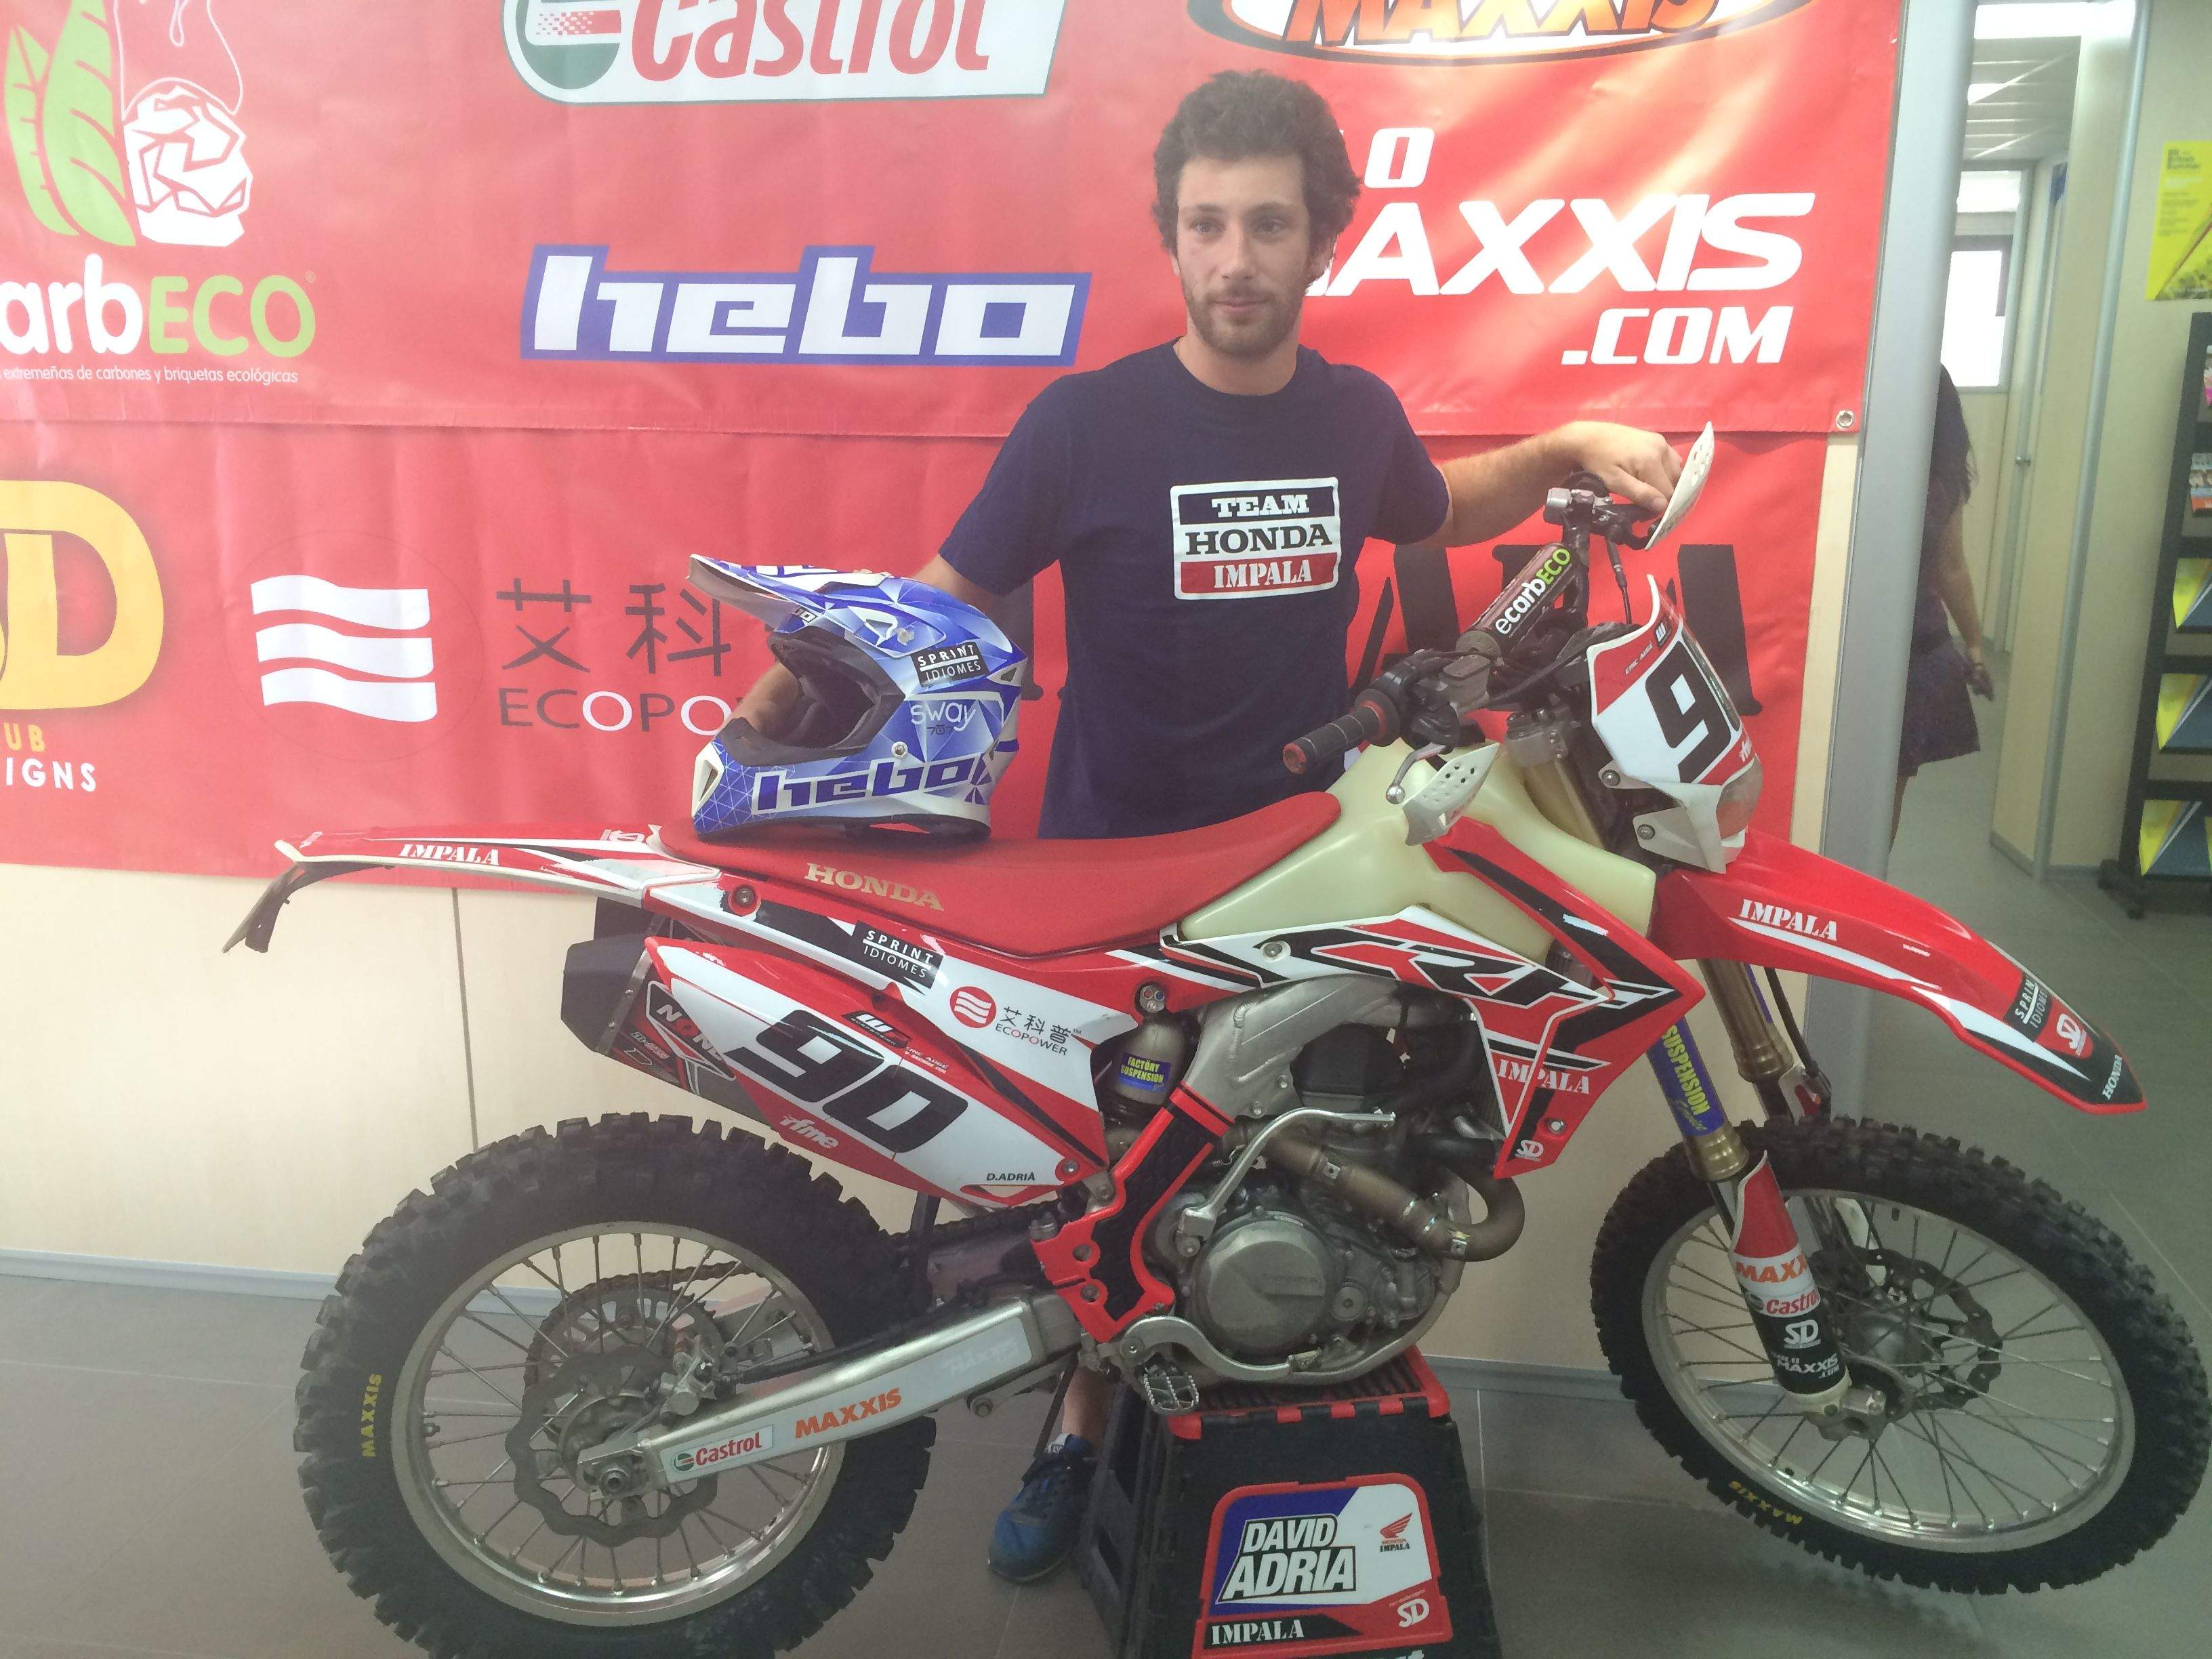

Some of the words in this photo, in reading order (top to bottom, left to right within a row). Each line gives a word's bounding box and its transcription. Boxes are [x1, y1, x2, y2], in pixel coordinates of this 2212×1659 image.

[1364, 127, 1435, 188] O
[1305, 192, 1816, 297] AXXIS
[534, 255, 1076, 356] hebo
[1561, 306, 1794, 365] .COM
[3, 365, 74, 381] extremeñas
[77, 365, 93, 380] de
[96, 365, 151, 381] carbones
[155, 371, 161, 384] y
[164, 365, 224, 384] briquetas
[227, 366, 298, 386] ecológicas
[1212, 494, 1309, 518] TEAM
[1185, 524, 1332, 556] HONDA
[1213, 558, 1312, 589] IMPALA
[1495, 548, 1571, 634] ecarbECO
[497, 578, 732, 676] 艾科
[918, 644, 975, 667] SPRINT
[926, 661, 981, 682] IDIOMES
[498, 688, 732, 736] ECOPO
[757, 757, 977, 811] hebo
[398, 843, 499, 865] IMPALA
[804, 862, 944, 911] HONDA
[1740, 898, 1839, 941] IMPALA
[864, 945, 926, 978] IDIOMES
[865, 930, 934, 965] SPRINT
[2015, 979, 2036, 1019] SPRIN
[2029, 989, 2048, 1029] IDIOME
[996, 1023, 1068, 1056] ECOPOWER
[1000, 1006, 1071, 1044] 艾科普
[723, 1008, 969, 1153] 90
[1121, 1065, 1164, 1084] SUSPENSION
[1498, 1059, 1590, 1094] IMPALA
[1662, 1025, 1711, 1115] SUSPENSION
[986, 1171, 1036, 1181] D.ADRIÀ
[1735, 1254, 1808, 1283] MAXX
[1766, 1287, 1820, 1315] Castro
[359, 1372, 382, 1458] MAXXIS
[794, 1387, 902, 1439] MAXXIS
[694, 1431, 764, 1466] Castrol
[1245, 1516, 1336, 1551] DAVID
[1380, 1542, 1410, 1553] IMPALA
[1221, 1547, 1355, 1601] ADRIA
[1211, 1618, 1305, 1646] IMPALA
